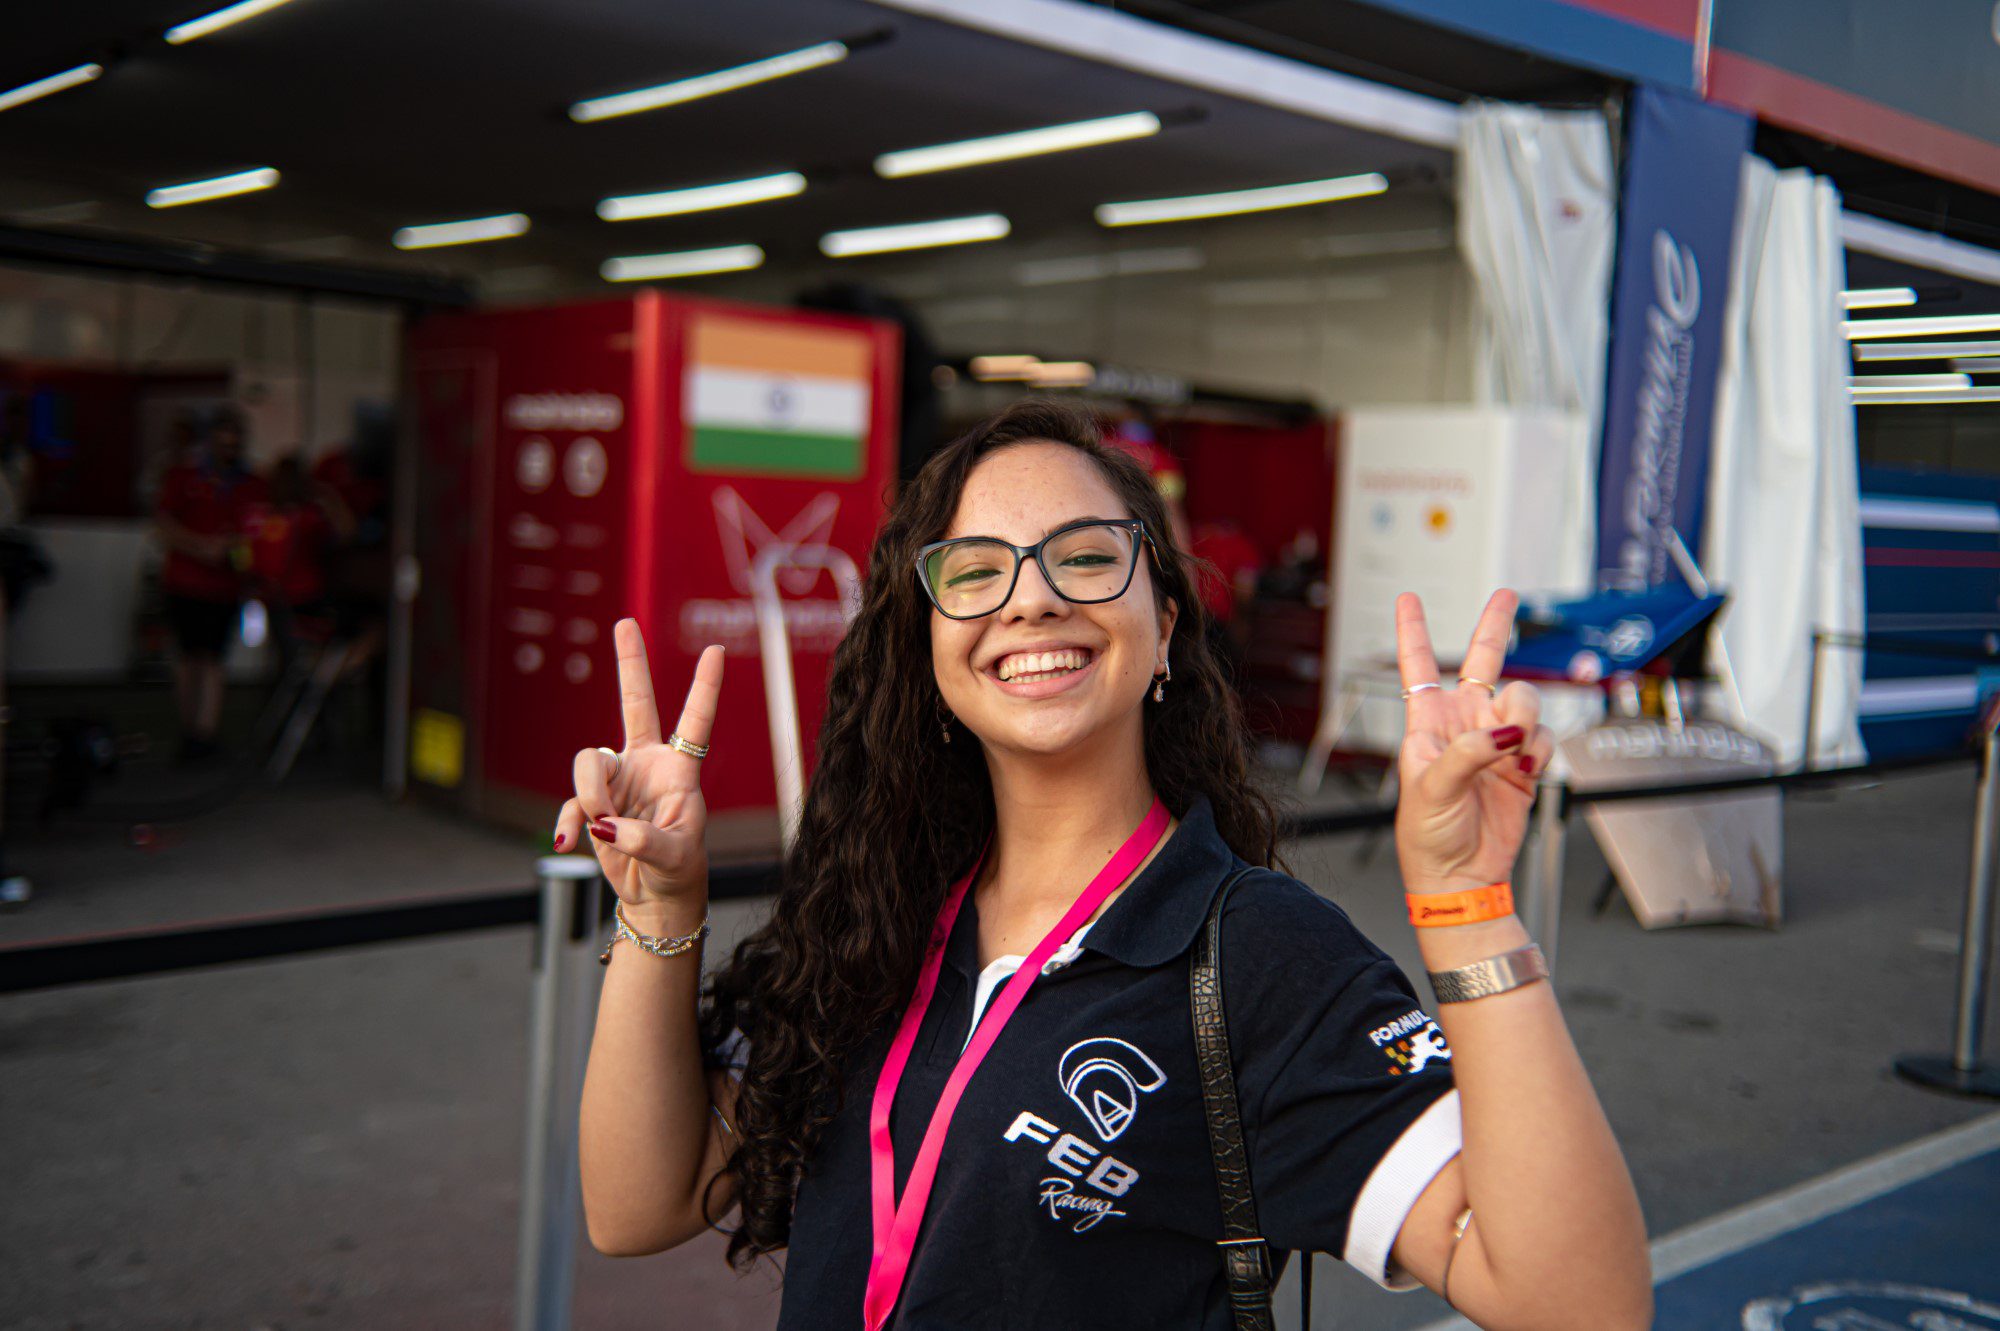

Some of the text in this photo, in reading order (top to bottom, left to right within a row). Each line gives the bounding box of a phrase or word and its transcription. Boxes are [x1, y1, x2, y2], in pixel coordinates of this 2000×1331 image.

[1368, 1009, 1432, 1047] FORMUL
[1003, 1110, 1141, 1197] FEB
[1038, 1176, 1127, 1234] Racing
